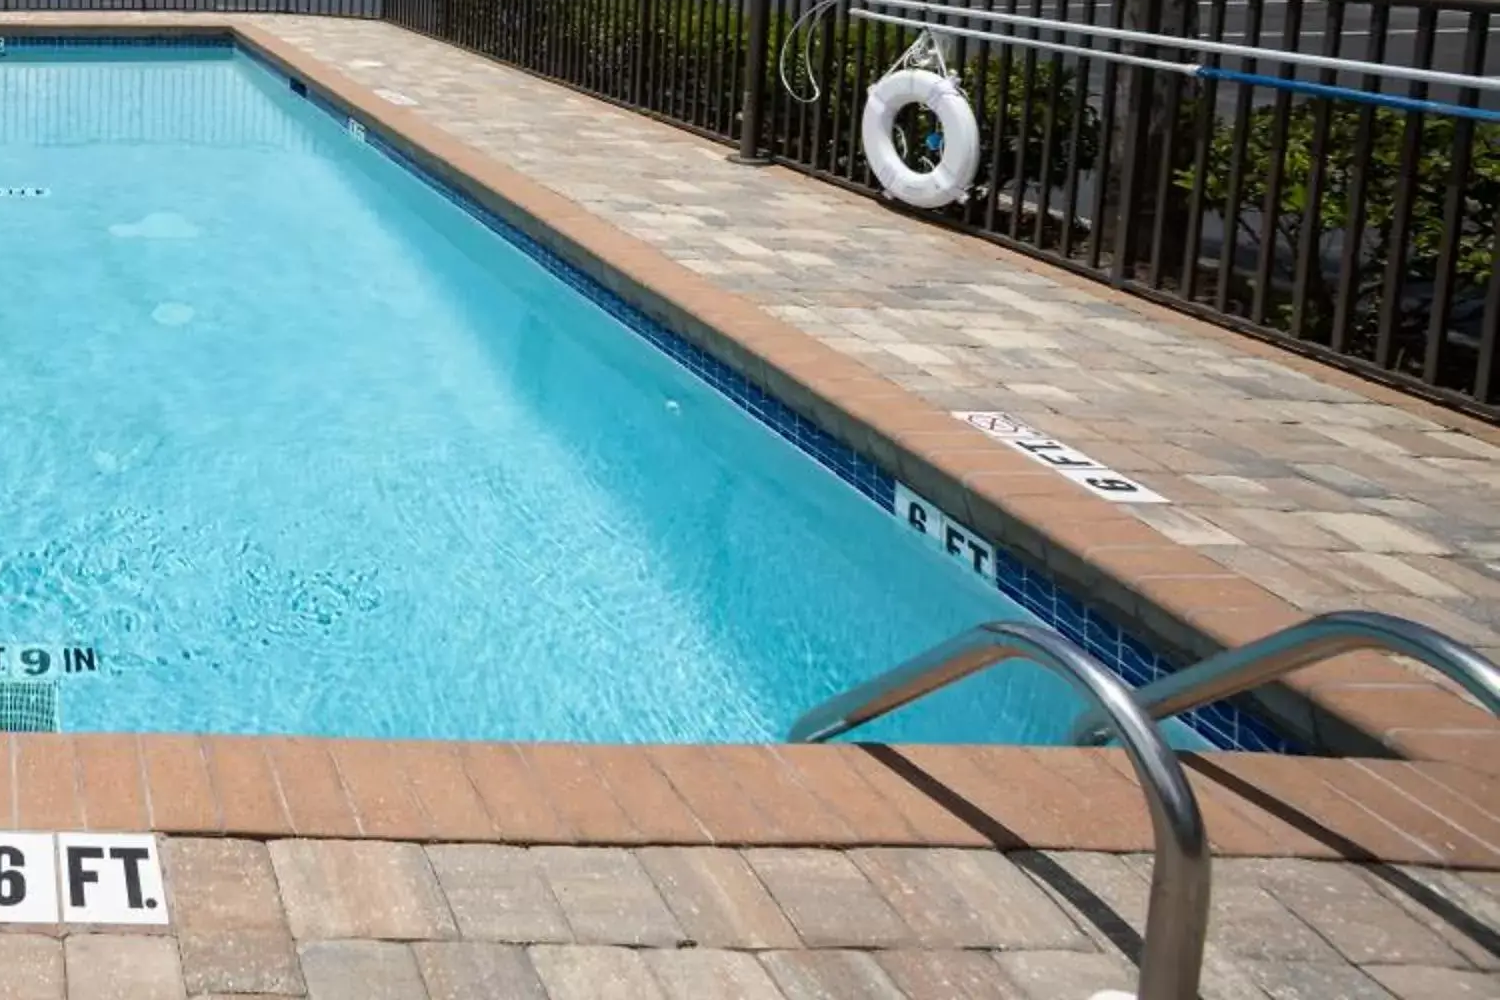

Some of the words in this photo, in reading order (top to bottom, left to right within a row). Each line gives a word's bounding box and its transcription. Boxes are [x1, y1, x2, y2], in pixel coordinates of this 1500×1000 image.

[908, 501, 927, 535] 6
[20, 648, 51, 676] 9
[63, 647, 96, 673] IN
[66, 846, 158, 910] FT.
